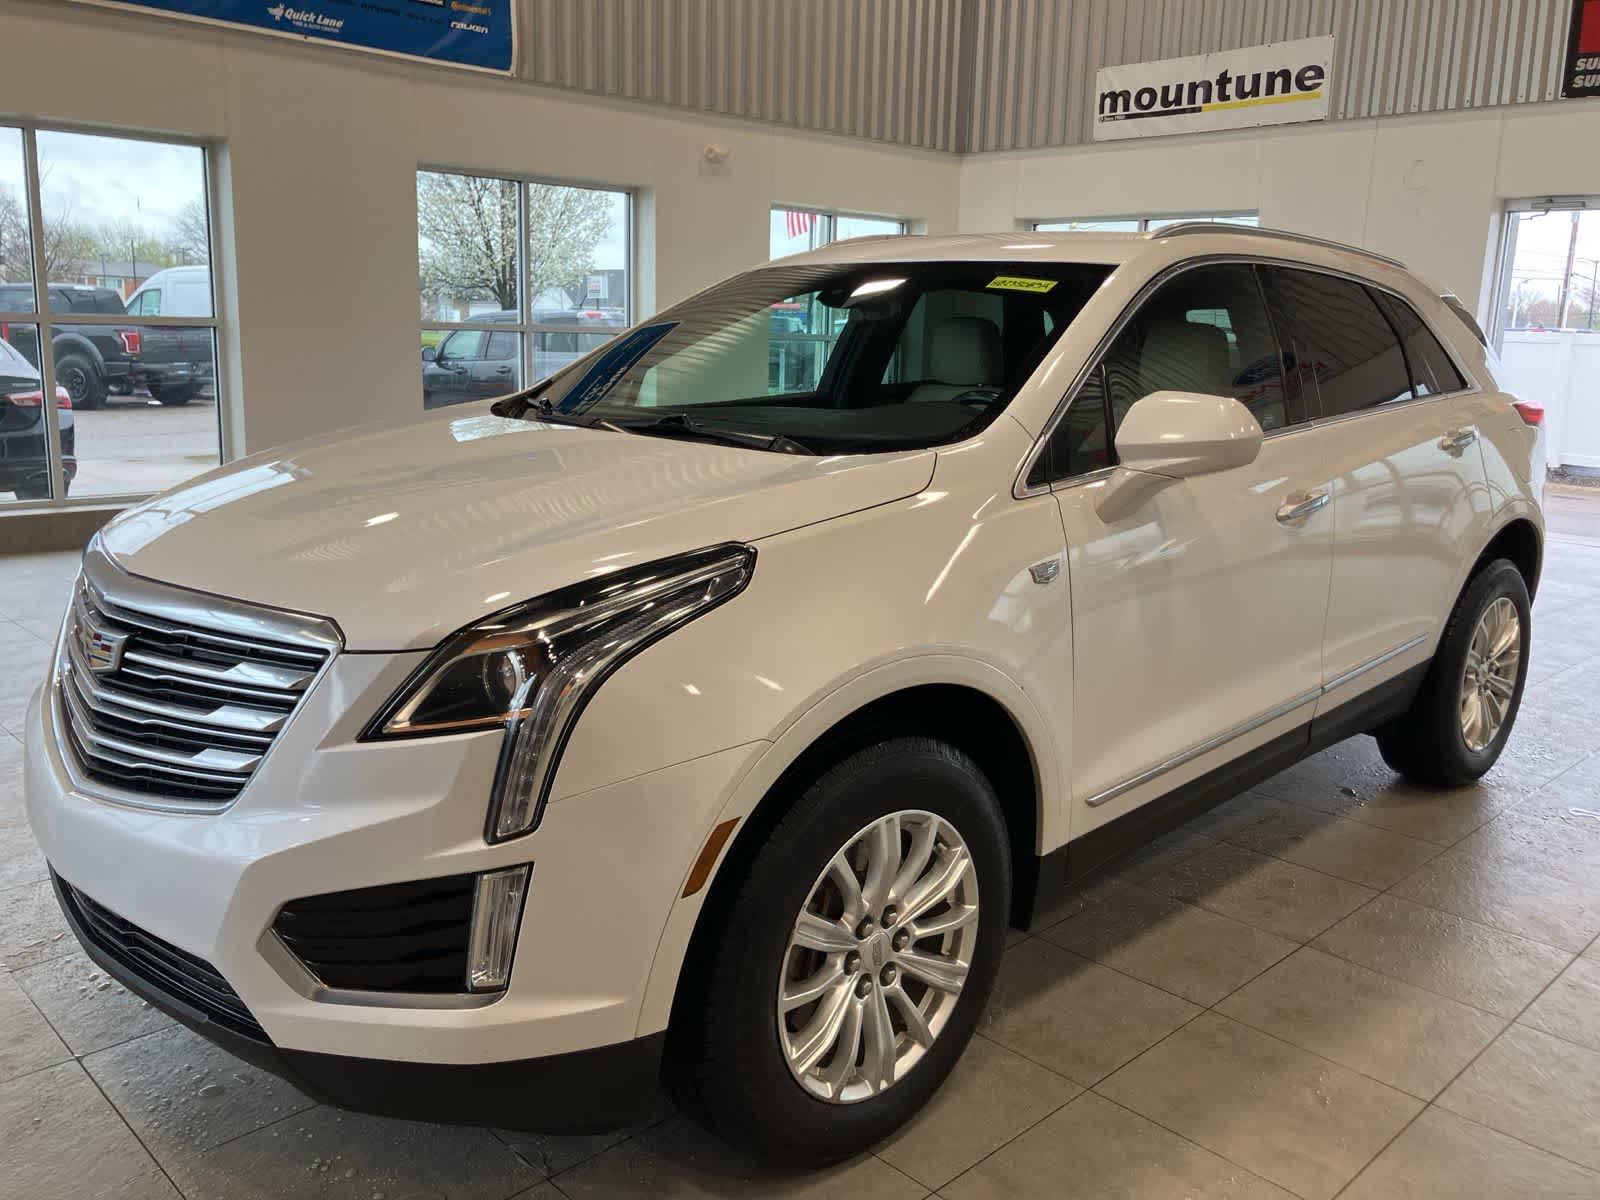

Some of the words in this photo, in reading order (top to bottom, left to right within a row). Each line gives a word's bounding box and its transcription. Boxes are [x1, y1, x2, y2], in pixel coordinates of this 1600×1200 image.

[285, 8, 317, 23] Quick
[316, 14, 344, 28] Lane
[1098, 64, 1325, 114] mountune
